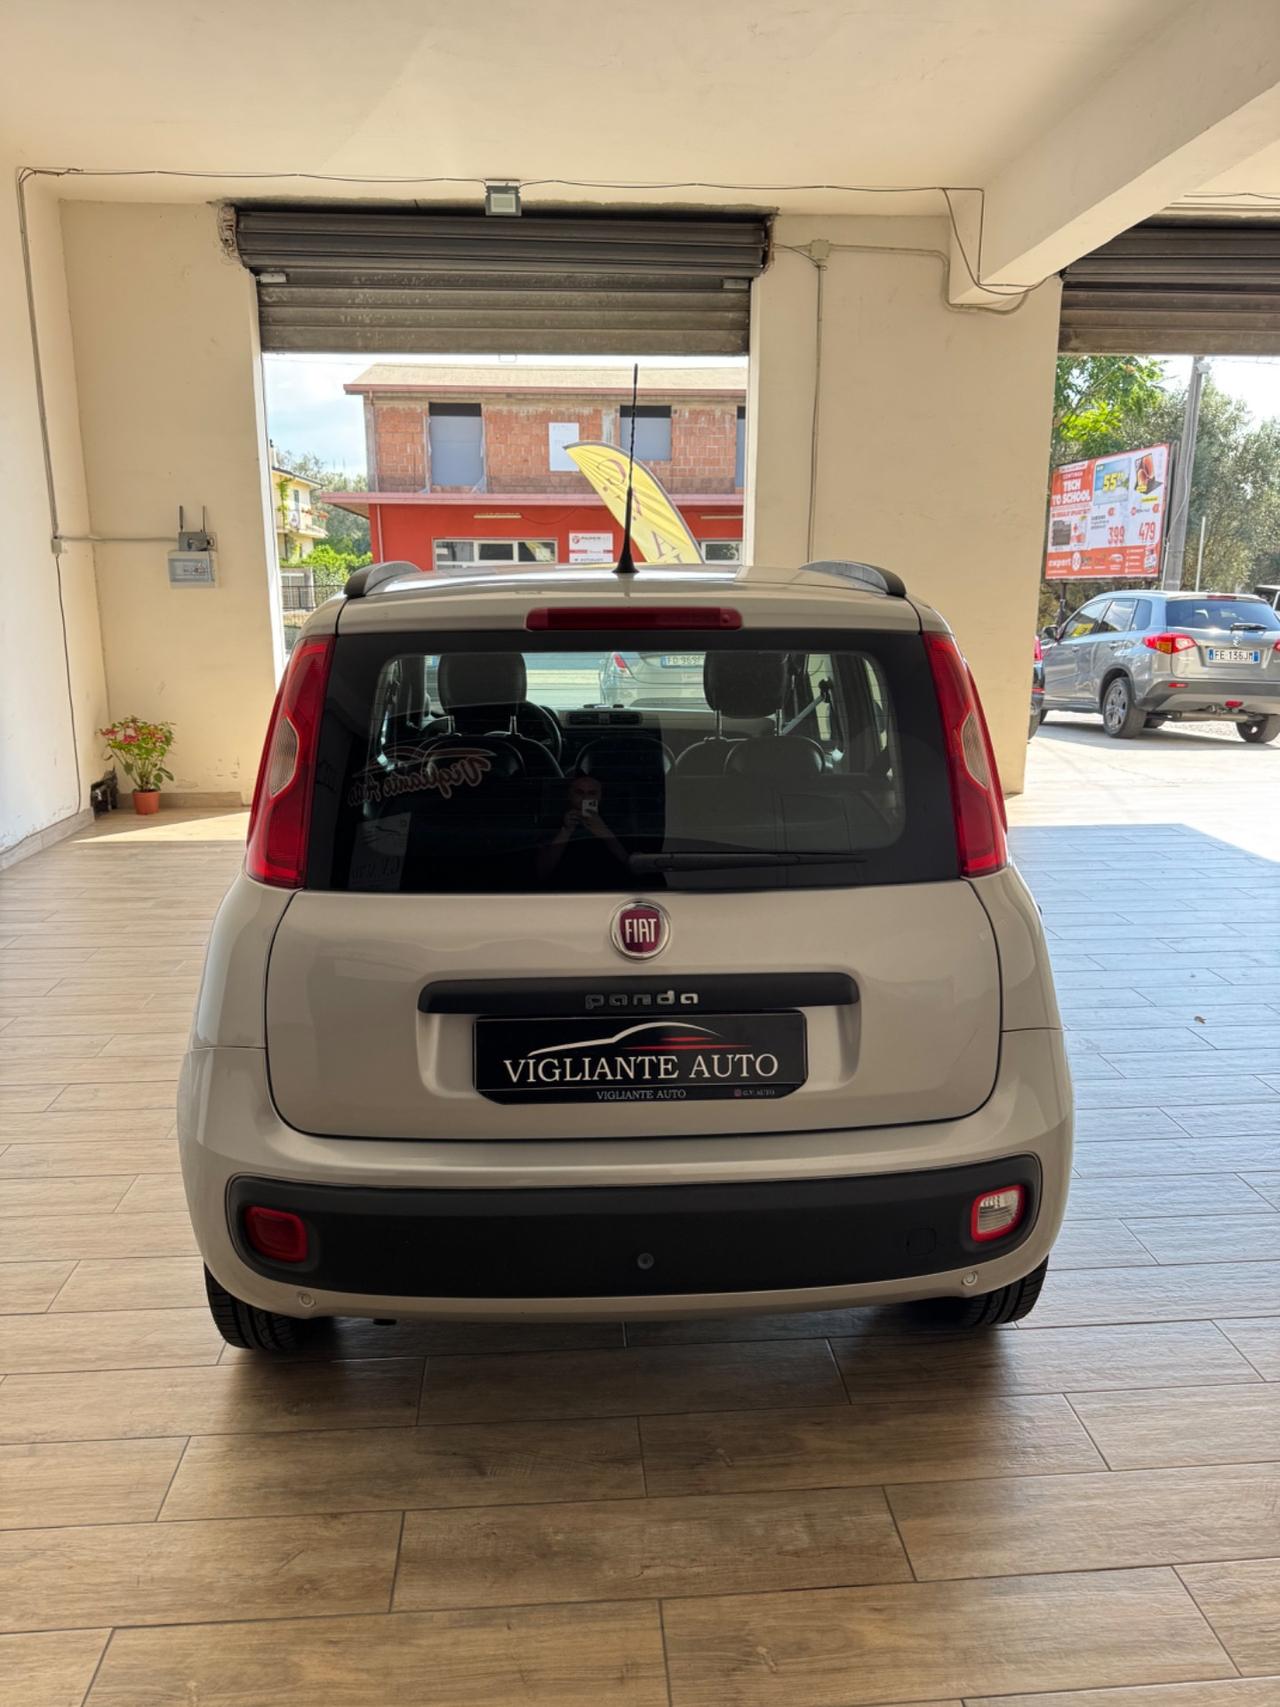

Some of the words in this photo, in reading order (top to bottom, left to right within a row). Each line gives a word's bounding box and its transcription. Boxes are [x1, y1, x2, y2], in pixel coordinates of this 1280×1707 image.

[1139, 521, 1156, 541] 479
[624, 918, 658, 944] FIAT
[584, 990, 699, 1010] panda
[503, 1055, 680, 1084] VIGLIANTE
[688, 1053, 779, 1079] AUTO
[596, 1089, 655, 1101] VIGLIANTE
[656, 1087, 687, 1099] AUTO
